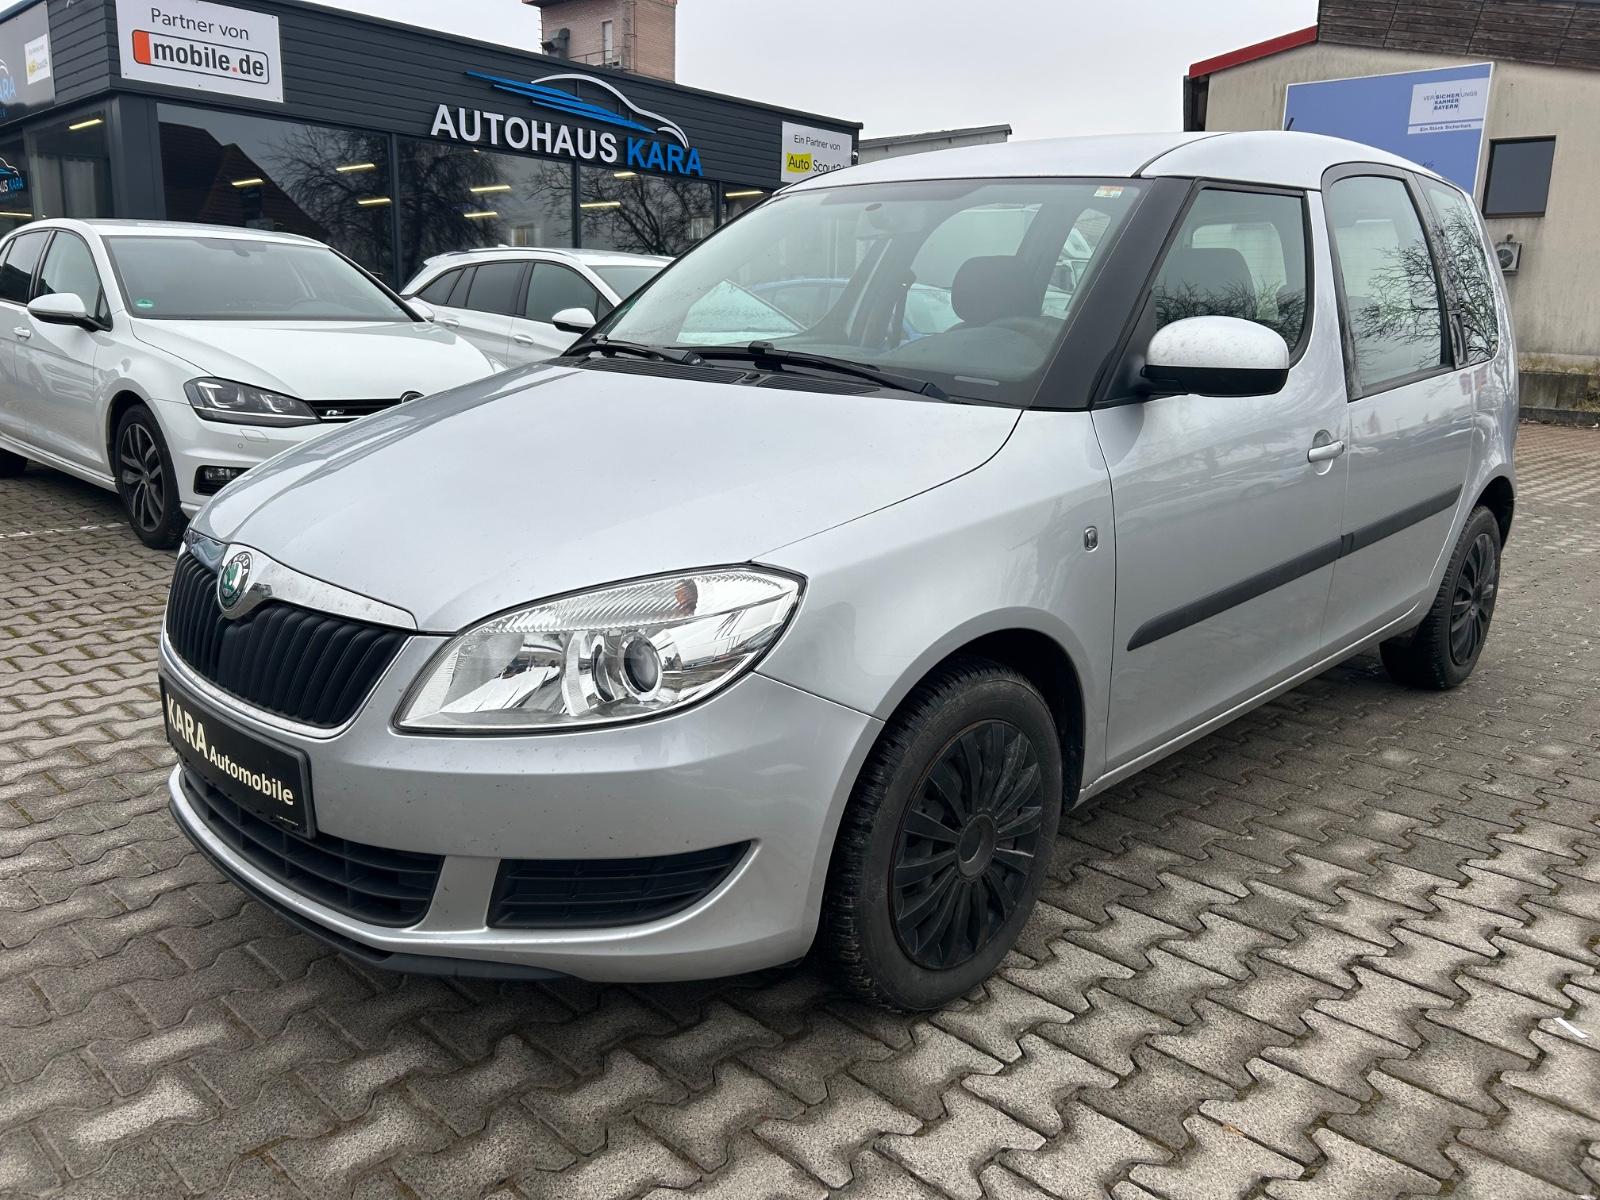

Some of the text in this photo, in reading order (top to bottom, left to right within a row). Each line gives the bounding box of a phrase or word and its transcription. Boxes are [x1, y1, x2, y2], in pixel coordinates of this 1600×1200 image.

[150, 7, 249, 41] Partner von
[153, 42, 264, 77] mobile.de
[430, 104, 704, 176] AUTOHAUS KARA
[794, 134, 841, 151] Ein Partner von
[788, 155, 809, 170] Auto
[166, 693, 294, 806] KARA Automobile
